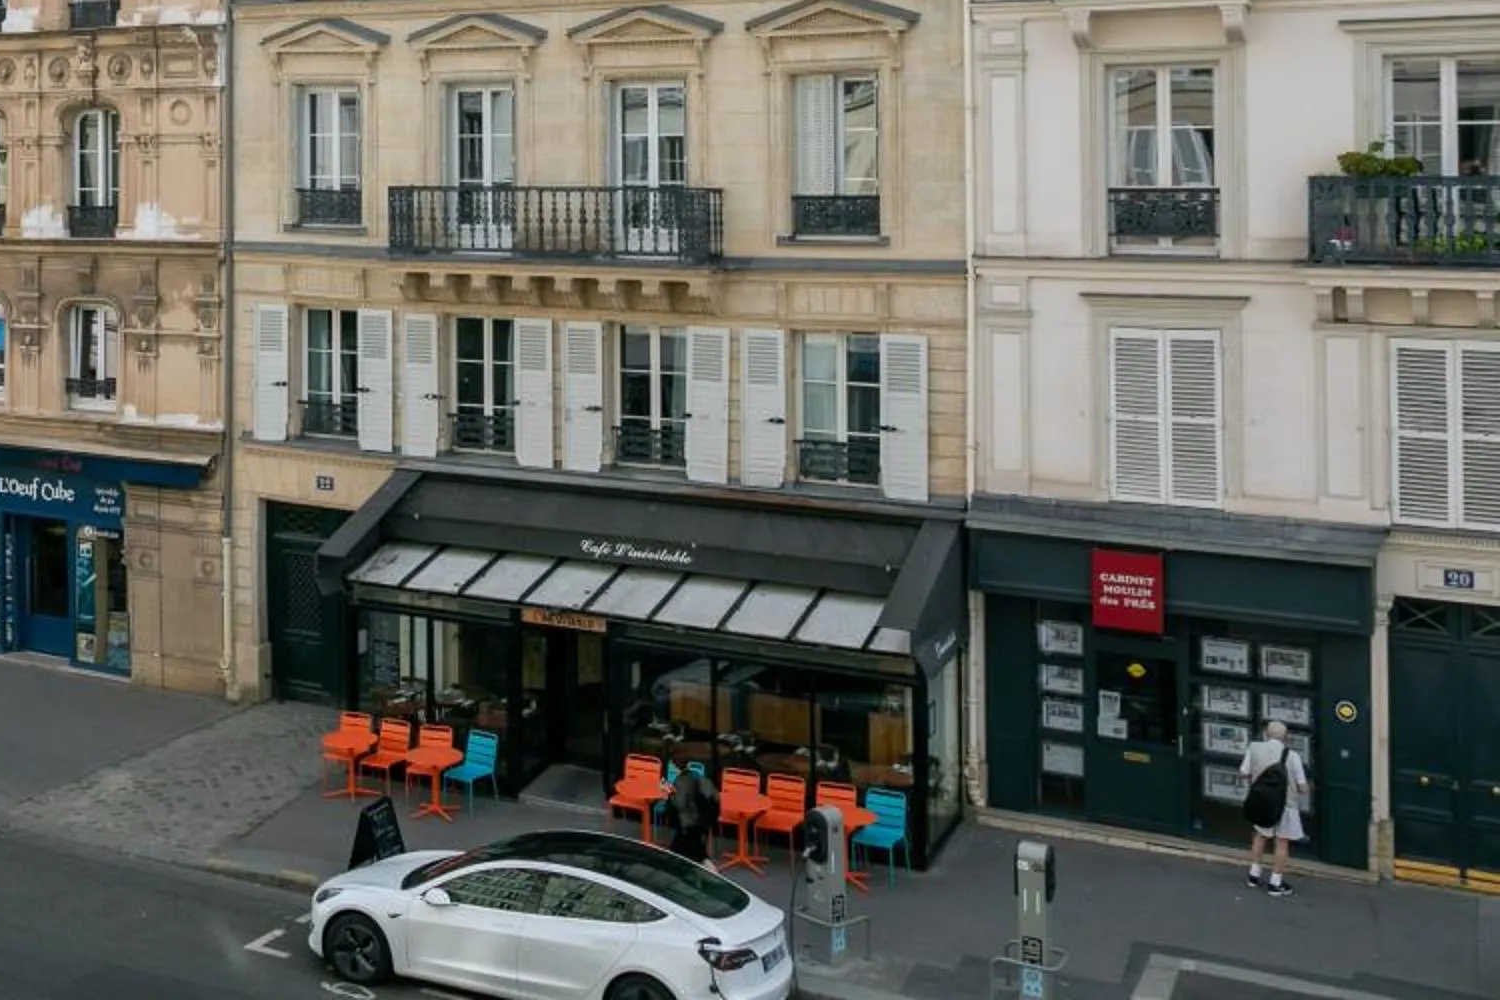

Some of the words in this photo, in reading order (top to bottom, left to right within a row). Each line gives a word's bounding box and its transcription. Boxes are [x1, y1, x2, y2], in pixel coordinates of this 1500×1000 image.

[41, 480, 76, 502] Cube
[1100, 572, 1155, 586] CABINET
[1447, 571, 1471, 586] 20
[1103, 584, 1152, 597] MOULIN
